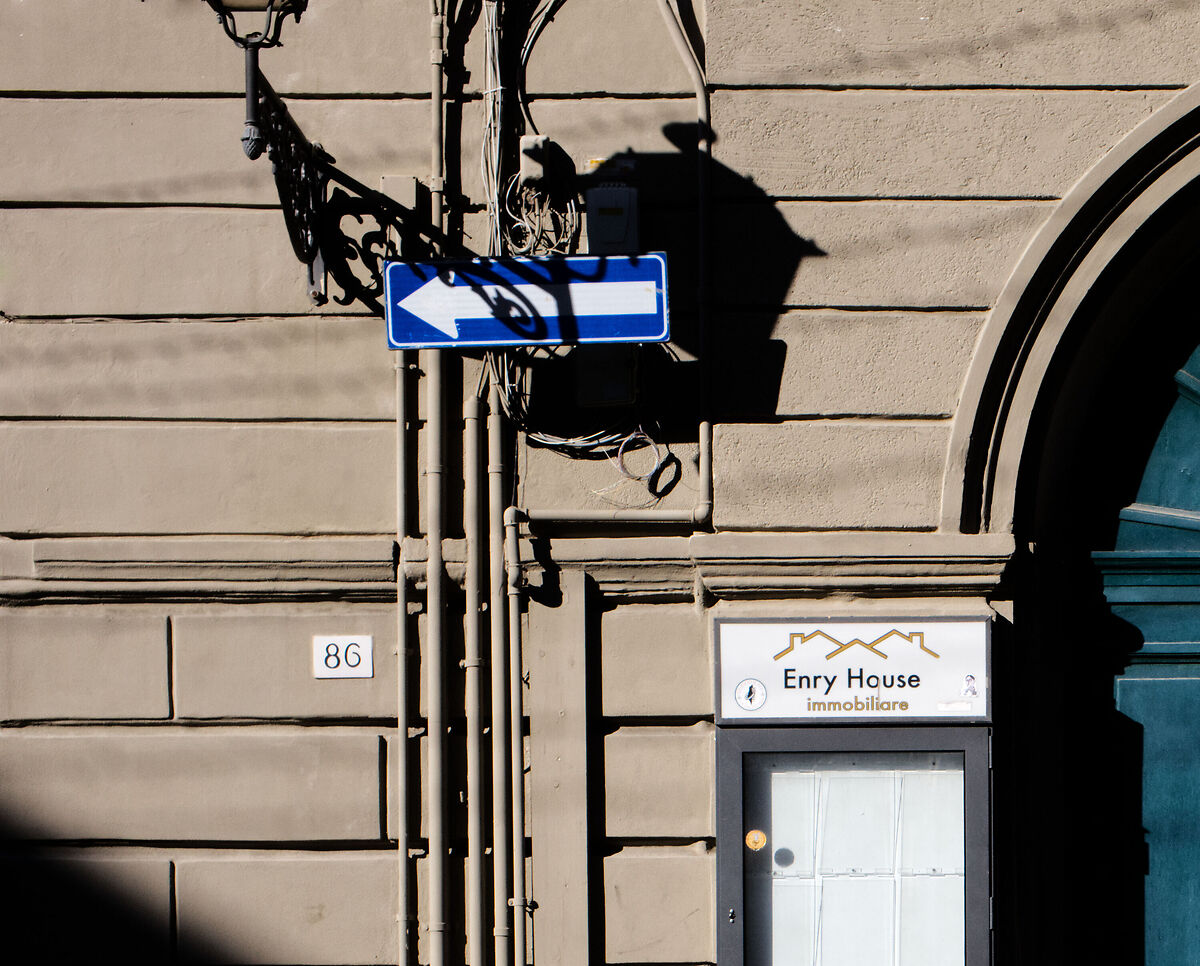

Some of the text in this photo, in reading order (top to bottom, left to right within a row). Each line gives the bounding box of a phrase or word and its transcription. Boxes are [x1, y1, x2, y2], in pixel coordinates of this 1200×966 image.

[324, 642, 361, 669] 86
[783, 668, 921, 695] Enry House
[807, 696, 909, 712] immobiliare
